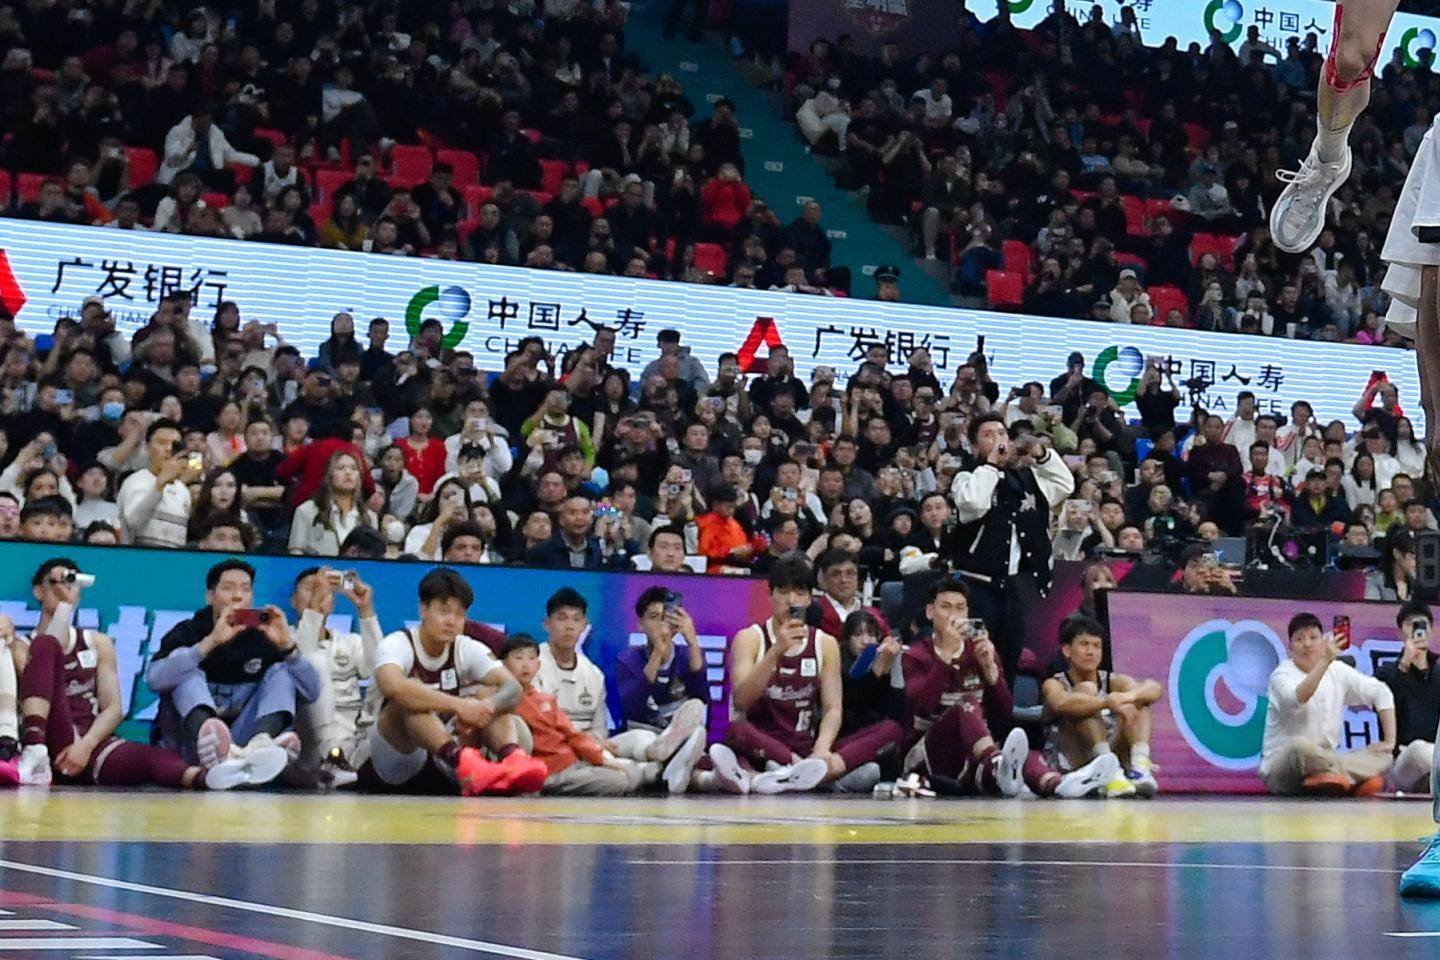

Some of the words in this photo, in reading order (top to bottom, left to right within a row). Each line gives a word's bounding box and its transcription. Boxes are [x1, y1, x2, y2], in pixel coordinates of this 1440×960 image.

[1113, 13, 1151, 30] LE
[52, 257, 228, 307] 广发银行
[487, 296, 647, 340] 中国人寿
[485, 336, 569, 354] CHA
[812, 324, 951, 370] 广发银行
[1158, 355, 1285, 392] 中国人寿
[1178, 392, 1227, 411] HINA
